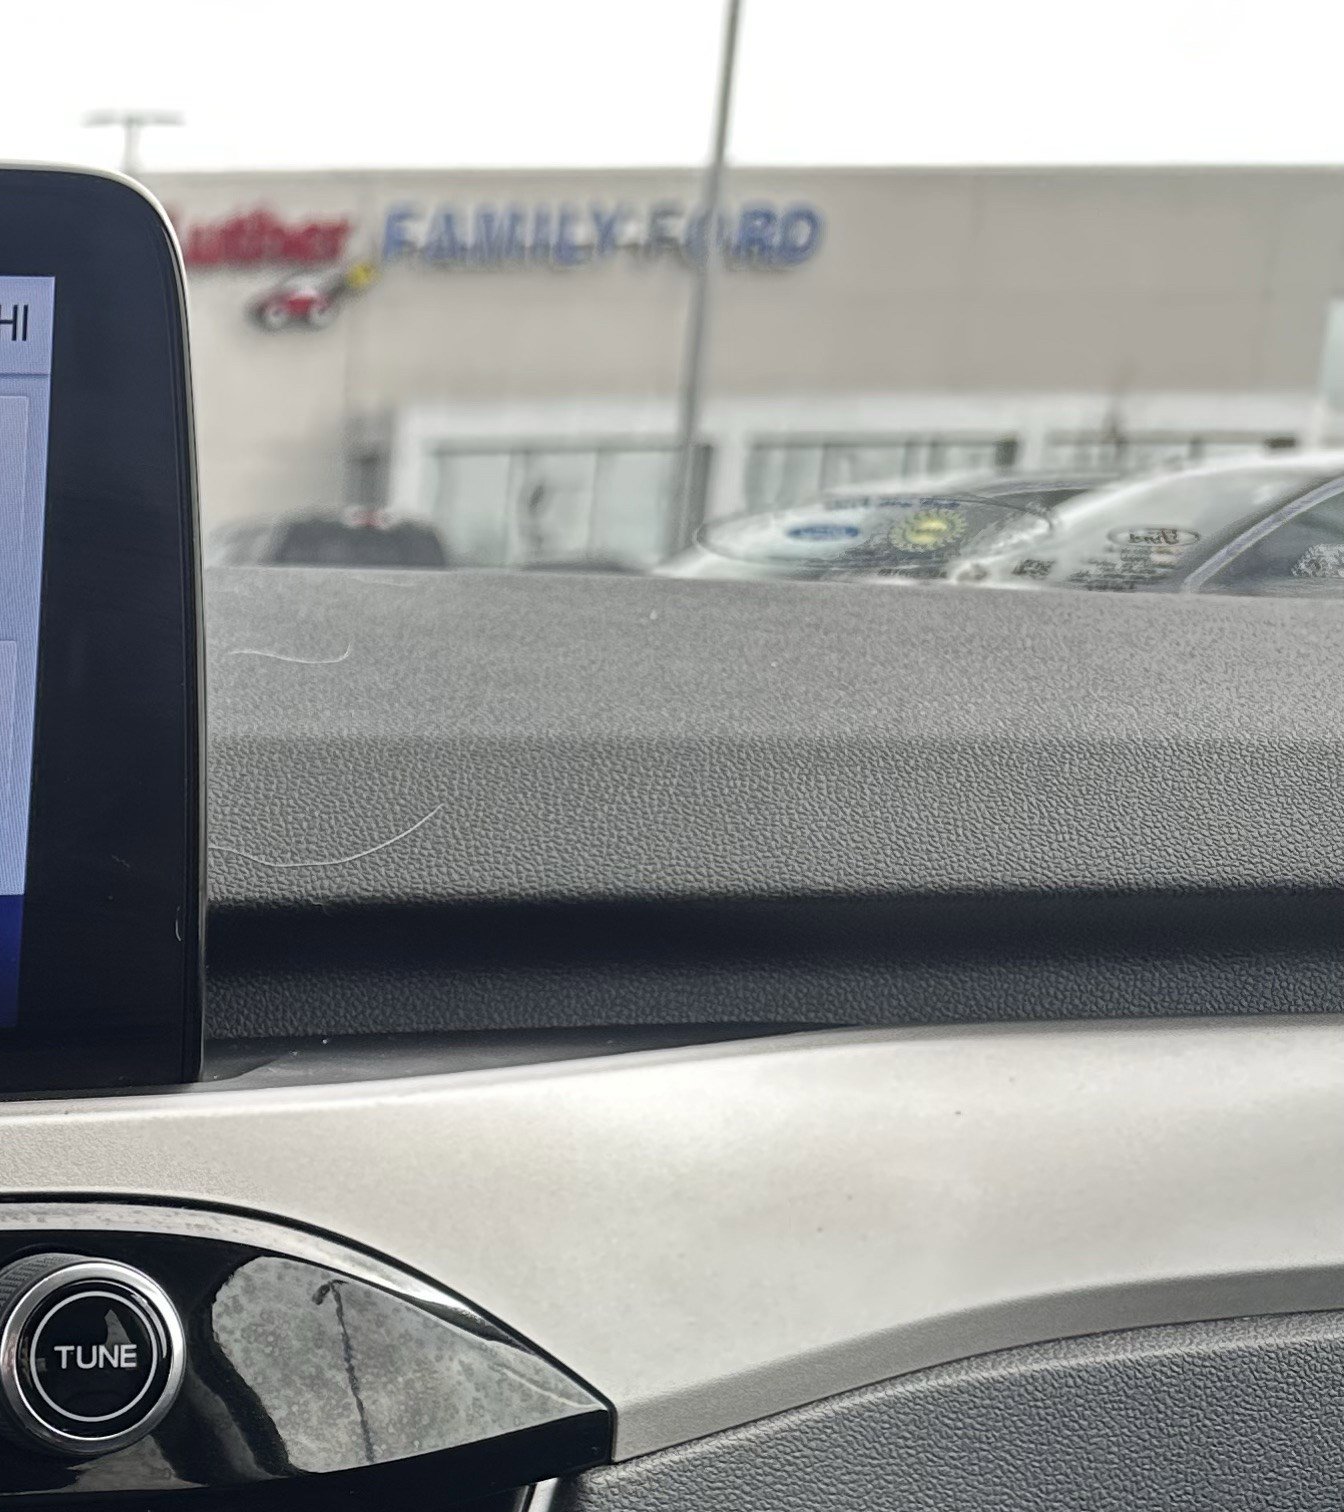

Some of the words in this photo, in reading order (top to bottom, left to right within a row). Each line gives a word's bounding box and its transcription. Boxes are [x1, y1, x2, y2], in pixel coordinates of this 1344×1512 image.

[174, 205, 353, 266] uther
[380, 206, 618, 265] FAMILY
[52, 1342, 138, 1370] TUNE
